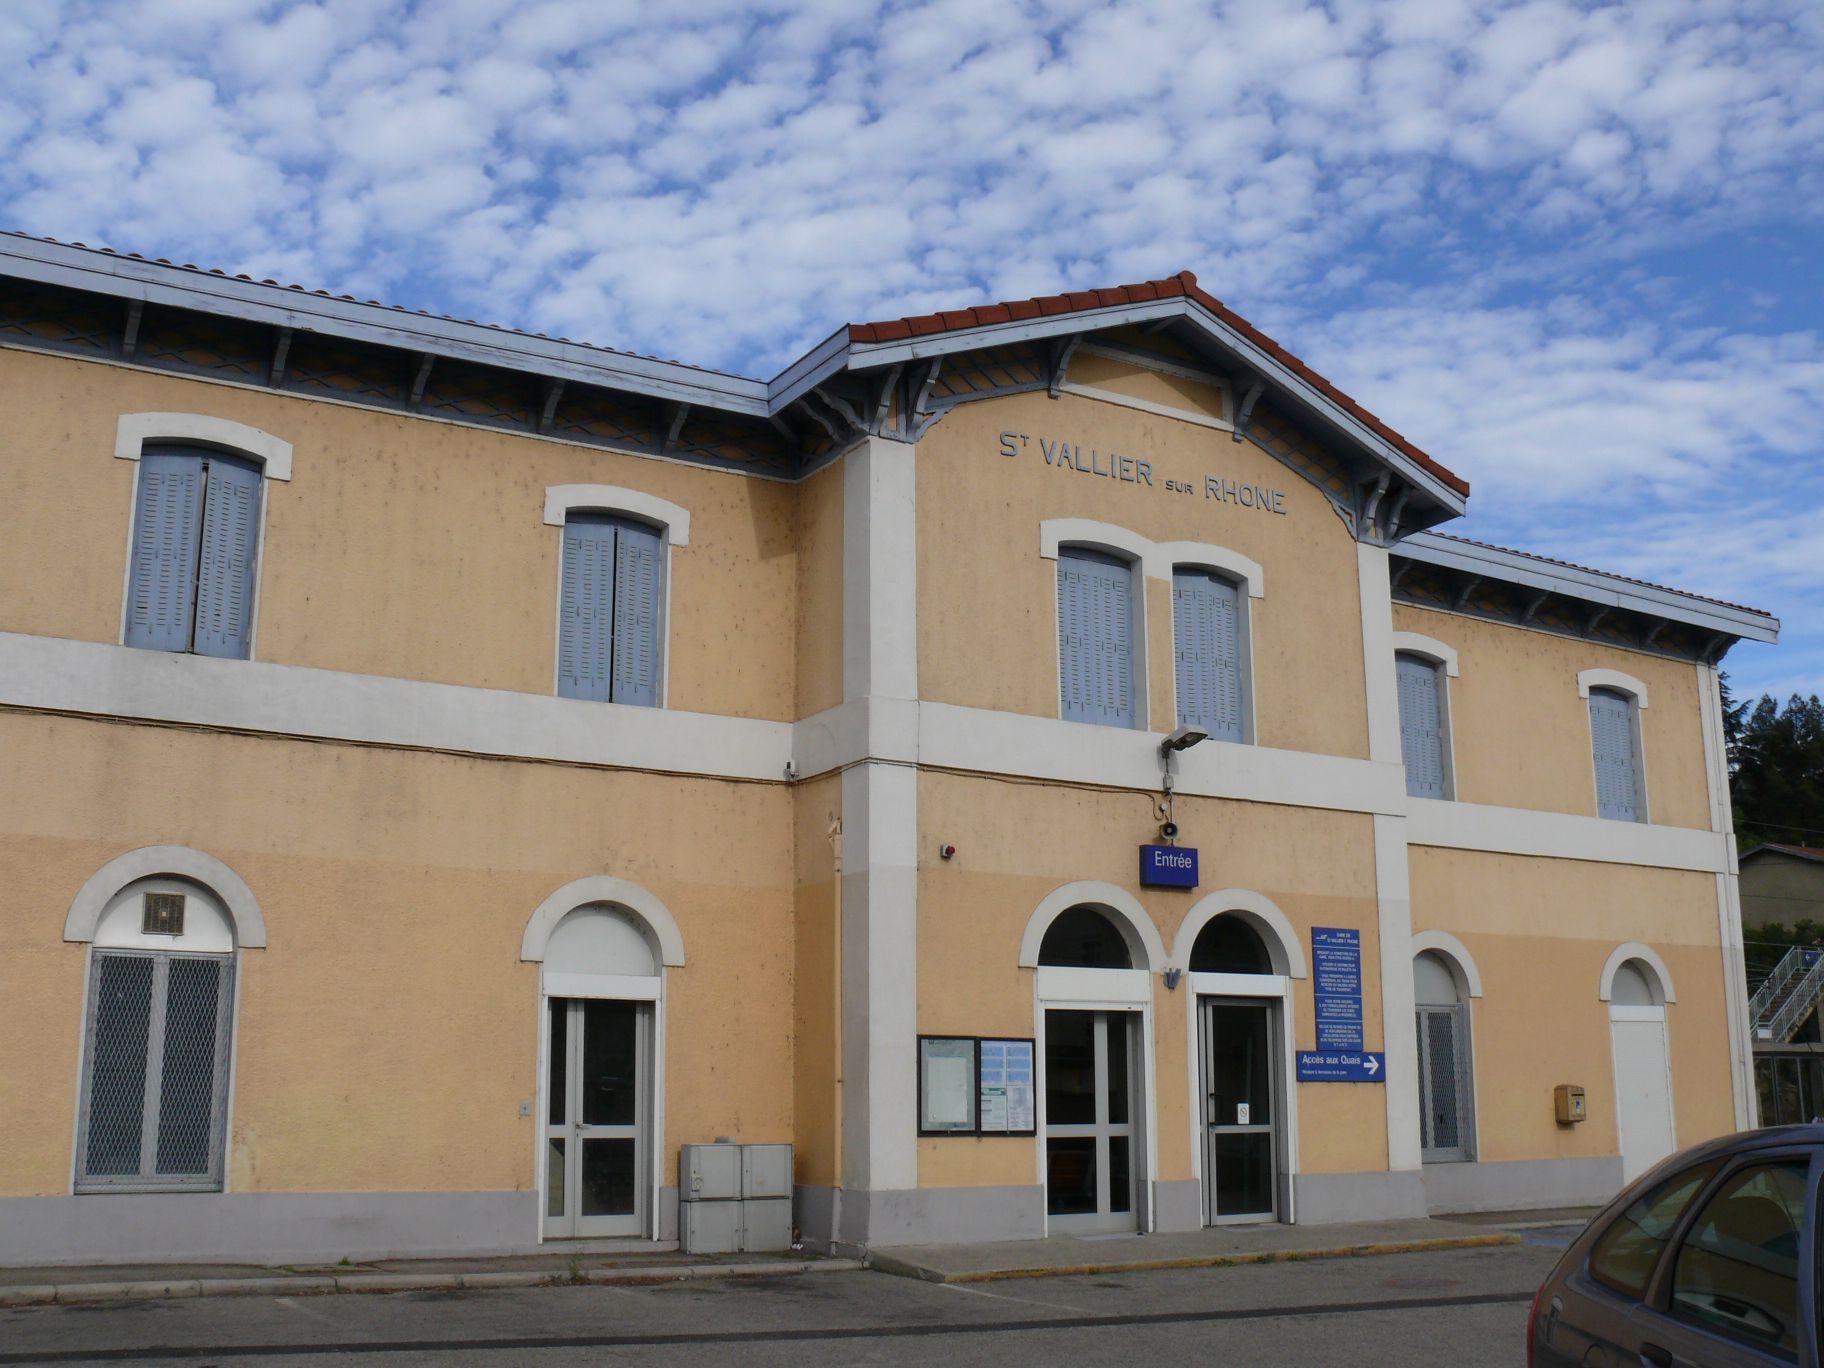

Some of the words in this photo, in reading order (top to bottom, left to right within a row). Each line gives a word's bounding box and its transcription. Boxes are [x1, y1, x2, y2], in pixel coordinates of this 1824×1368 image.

[1040, 438, 1153, 486] VALLIER
[1165, 480, 1194, 495] SUR
[1205, 474, 1287, 515] RHONE
[1155, 851, 1191, 868] Entrée
[1302, 1054, 1324, 1064] Accès
[1325, 1056, 1339, 1065] aux
[1340, 1055, 1361, 1065] Quais
